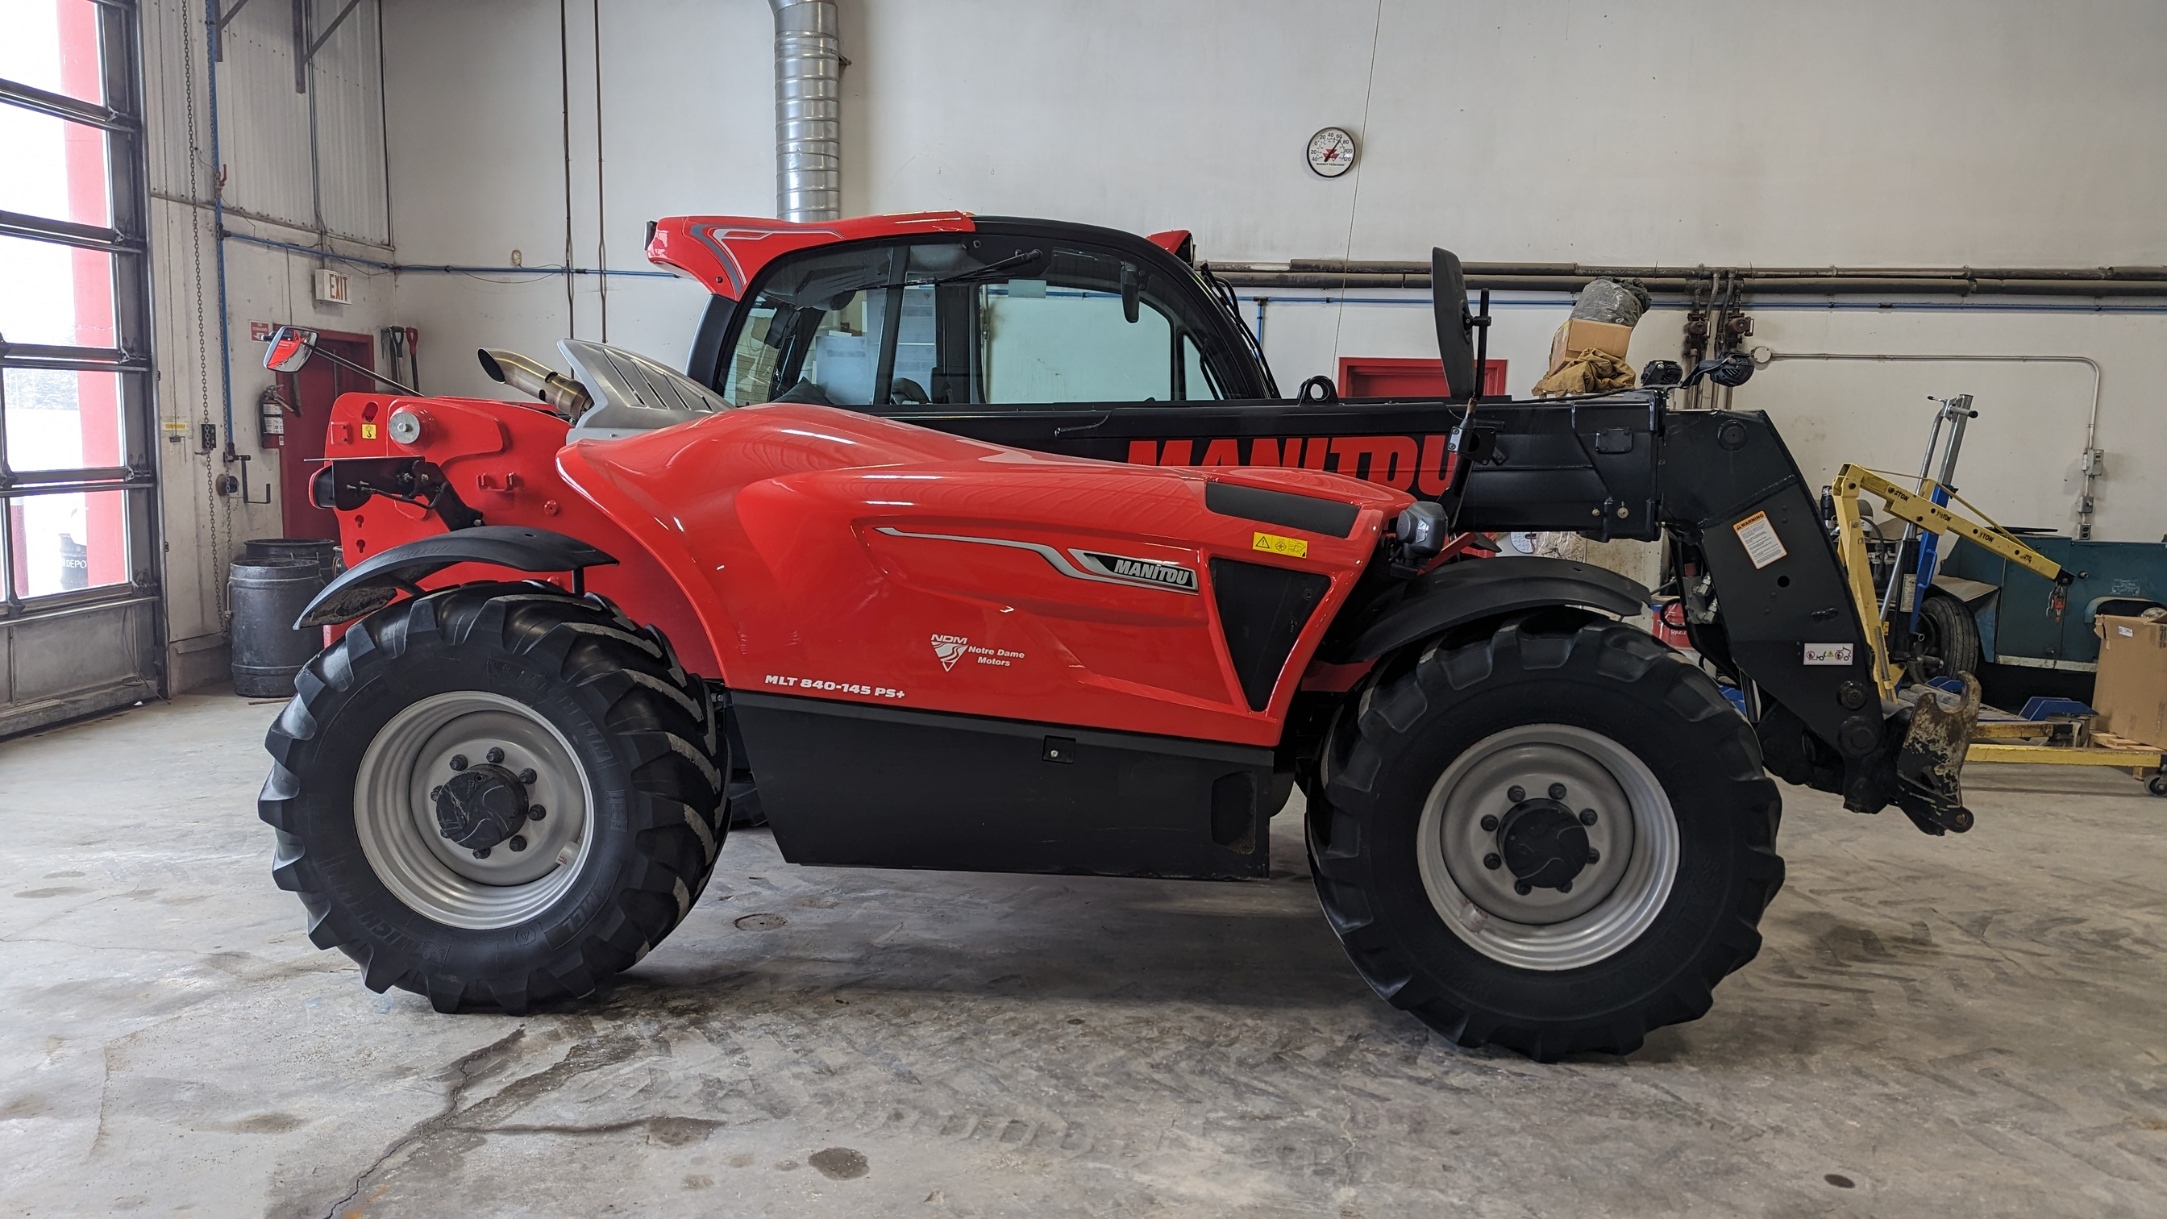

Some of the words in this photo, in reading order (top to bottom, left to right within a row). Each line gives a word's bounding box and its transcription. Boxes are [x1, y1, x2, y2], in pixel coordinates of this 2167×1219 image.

[329, 274, 347, 301] EXIT
[1114, 559, 1189, 585] MANITOU
[931, 634, 967, 644] NDM
[968, 646, 994, 655] Notre
[997, 649, 1025, 658] Dame
[978, 657, 1011, 667] Motors
[765, 675, 798, 686] MLT
[800, 679, 871, 695] 840-145
[874, 687, 905, 699] PS+
